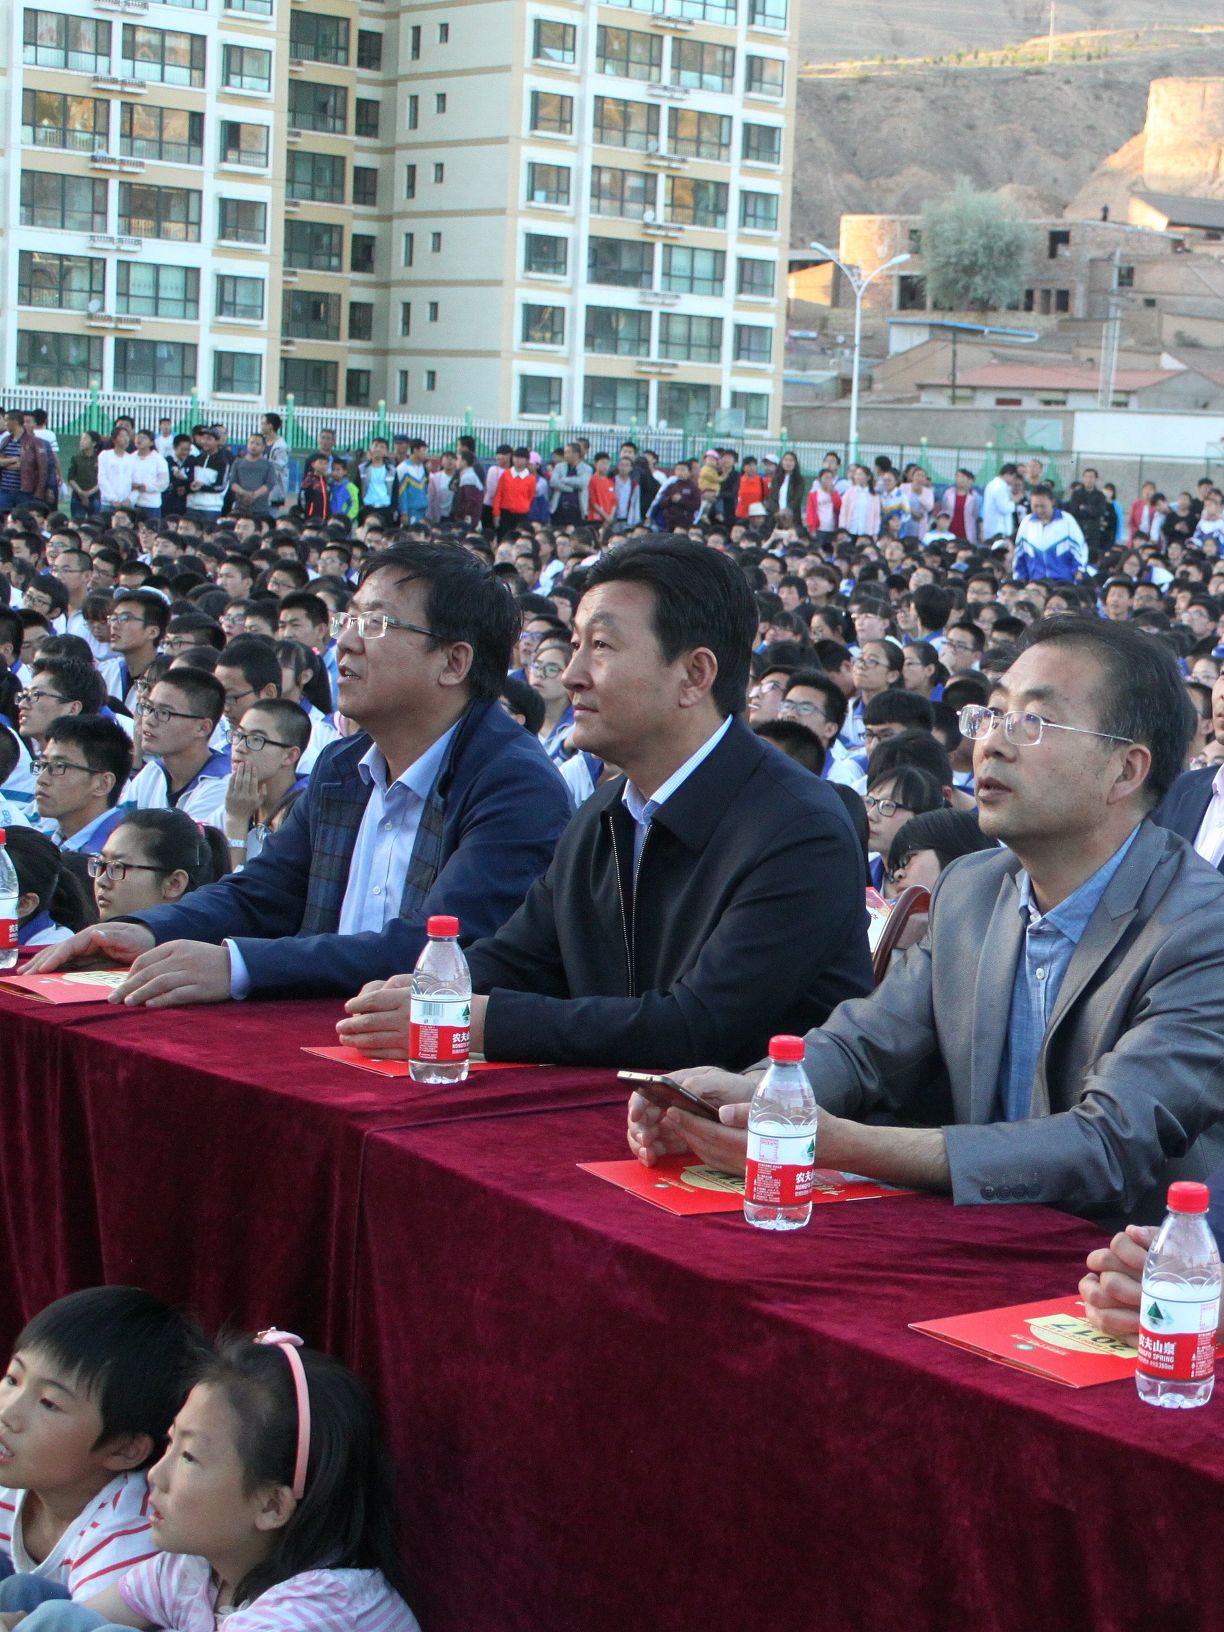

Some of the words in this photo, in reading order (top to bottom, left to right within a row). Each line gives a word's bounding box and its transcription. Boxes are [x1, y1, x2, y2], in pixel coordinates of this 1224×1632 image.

[452, 1031, 470, 1043] 农夫
[1051, 1323, 1133, 1352] 2017
[1153, 1353, 1175, 1363] SPRING
